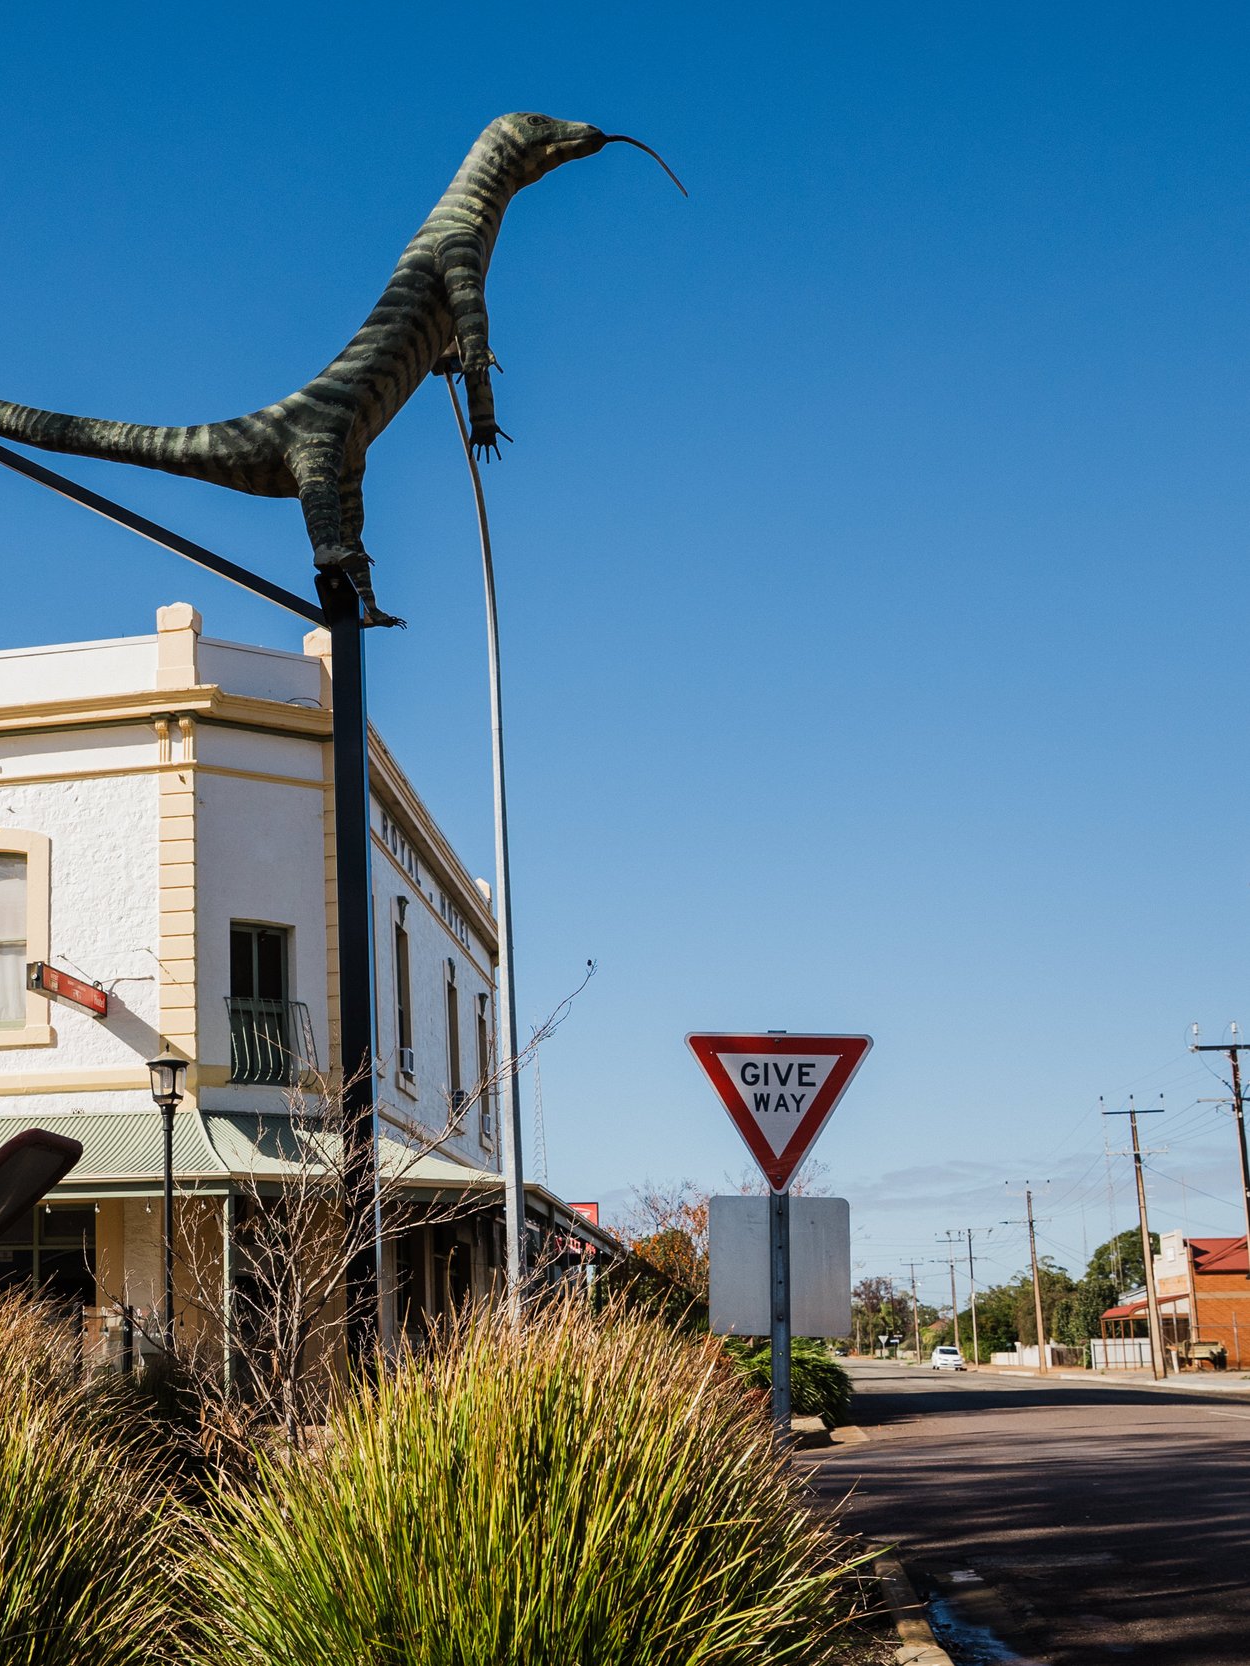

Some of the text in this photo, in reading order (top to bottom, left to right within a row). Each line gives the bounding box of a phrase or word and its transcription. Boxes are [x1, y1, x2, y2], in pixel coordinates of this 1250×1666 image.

[381, 811, 421, 887] ROYAL
[740, 1062, 816, 1087] GIVE
[753, 1093, 806, 1113] WAY
